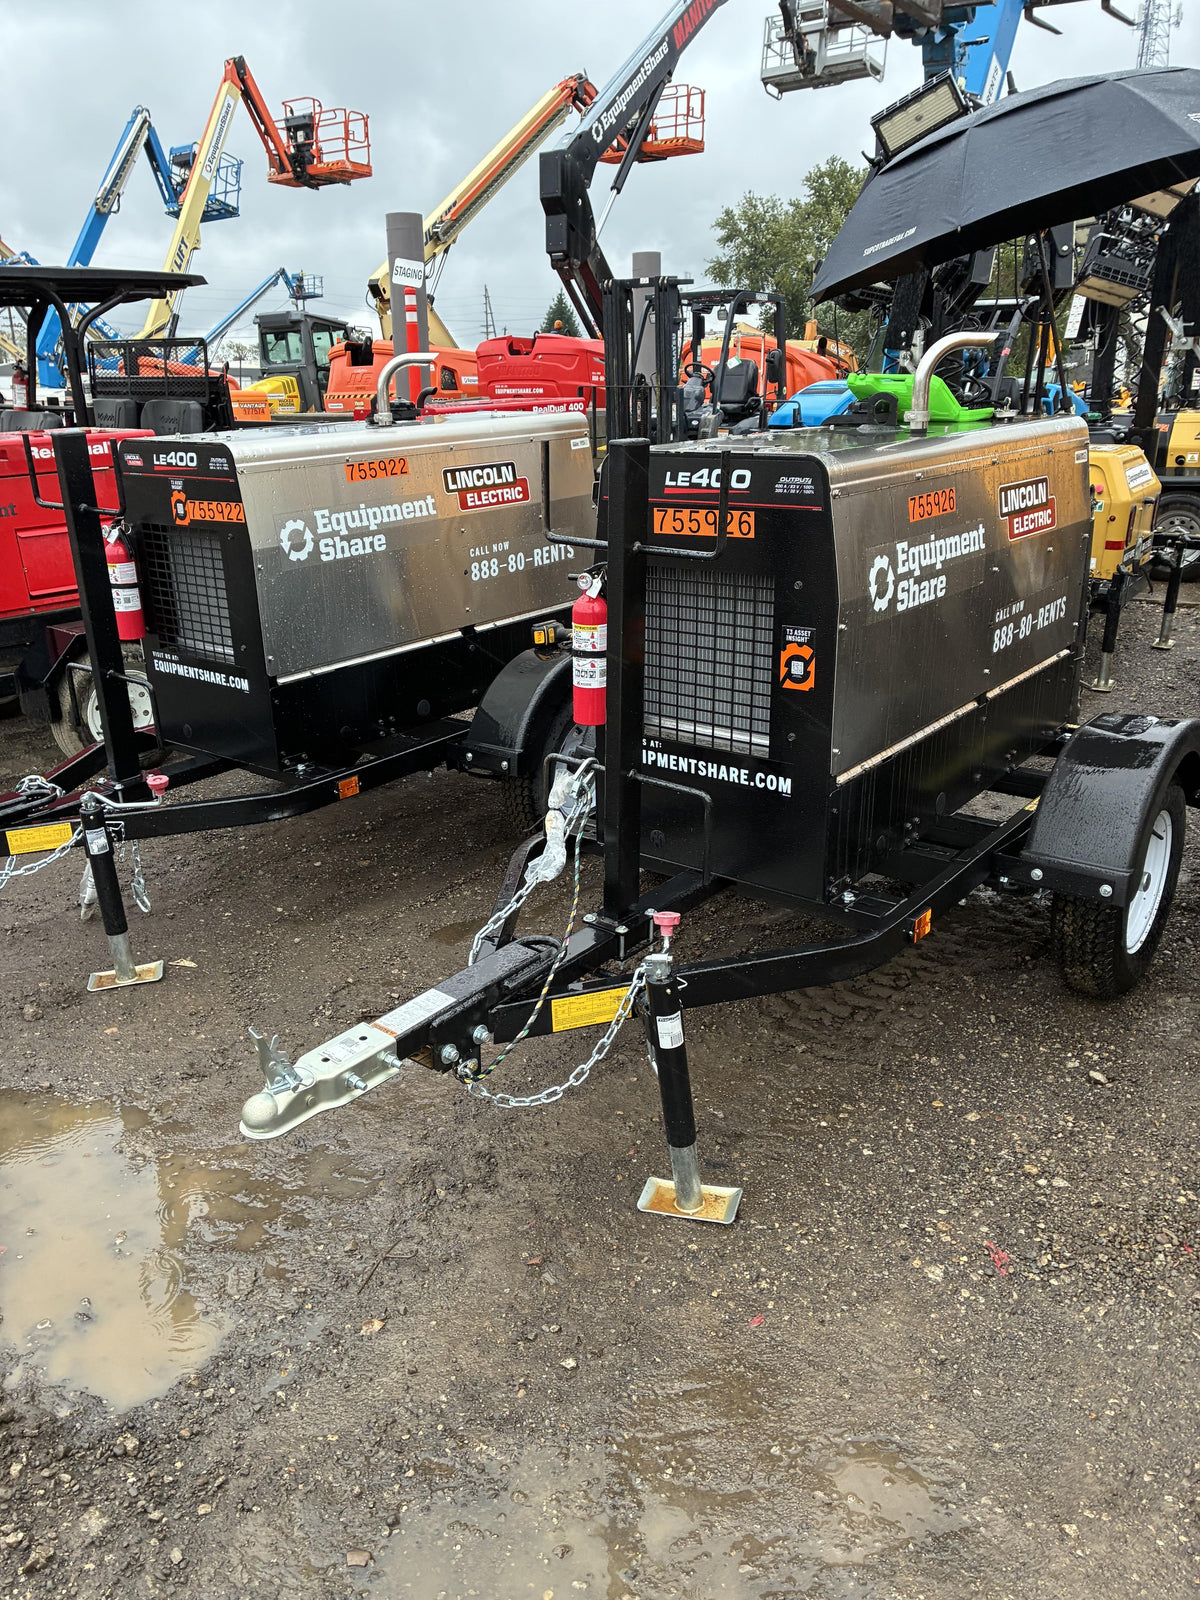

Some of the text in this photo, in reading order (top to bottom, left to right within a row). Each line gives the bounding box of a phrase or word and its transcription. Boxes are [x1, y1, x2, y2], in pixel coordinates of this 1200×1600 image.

[673, 0, 717, 50] MANIT
[601, 41, 669, 131] EquipmentShare
[207, 102, 232, 165] EquipmentShare
[173, 235, 190, 272] LIFT
[394, 265, 423, 280] STAGING
[495, 387, 544, 395] EQUIPMENTSHARE.COM
[568, 402, 584, 411] 400
[30, 441, 109, 460] Reaual
[153, 451, 197, 467] LE400
[346, 457, 408, 481] 755922
[446, 465, 514, 490] LINCOLN
[466, 486, 523, 507] ELECTRIC
[909, 488, 955, 520] 755926
[1001, 481, 1047, 514] LINCOLN
[189, 501, 243, 521] 755922
[313, 494, 437, 535] Equipment
[656, 509, 752, 536] 755926
[1013, 508, 1052, 534] ELECTRIC
[318, 533, 387, 562] Share
[469, 540, 510, 558] CALL NOW
[896, 523, 986, 576] Equipment
[471, 543, 575, 581] 888-80-RENTS
[896, 574, 947, 612] Share
[992, 596, 1067, 653] 888-80-RENTS
[995, 600, 1025, 623] CALL NOW
[785, 635, 808, 643] INSIGHT
[794, 629, 811, 637] ASSET
[153, 659, 249, 691] EQUIPMENTSHARE.COM
[642, 749, 792, 794] IPMENTSHARE.COM
